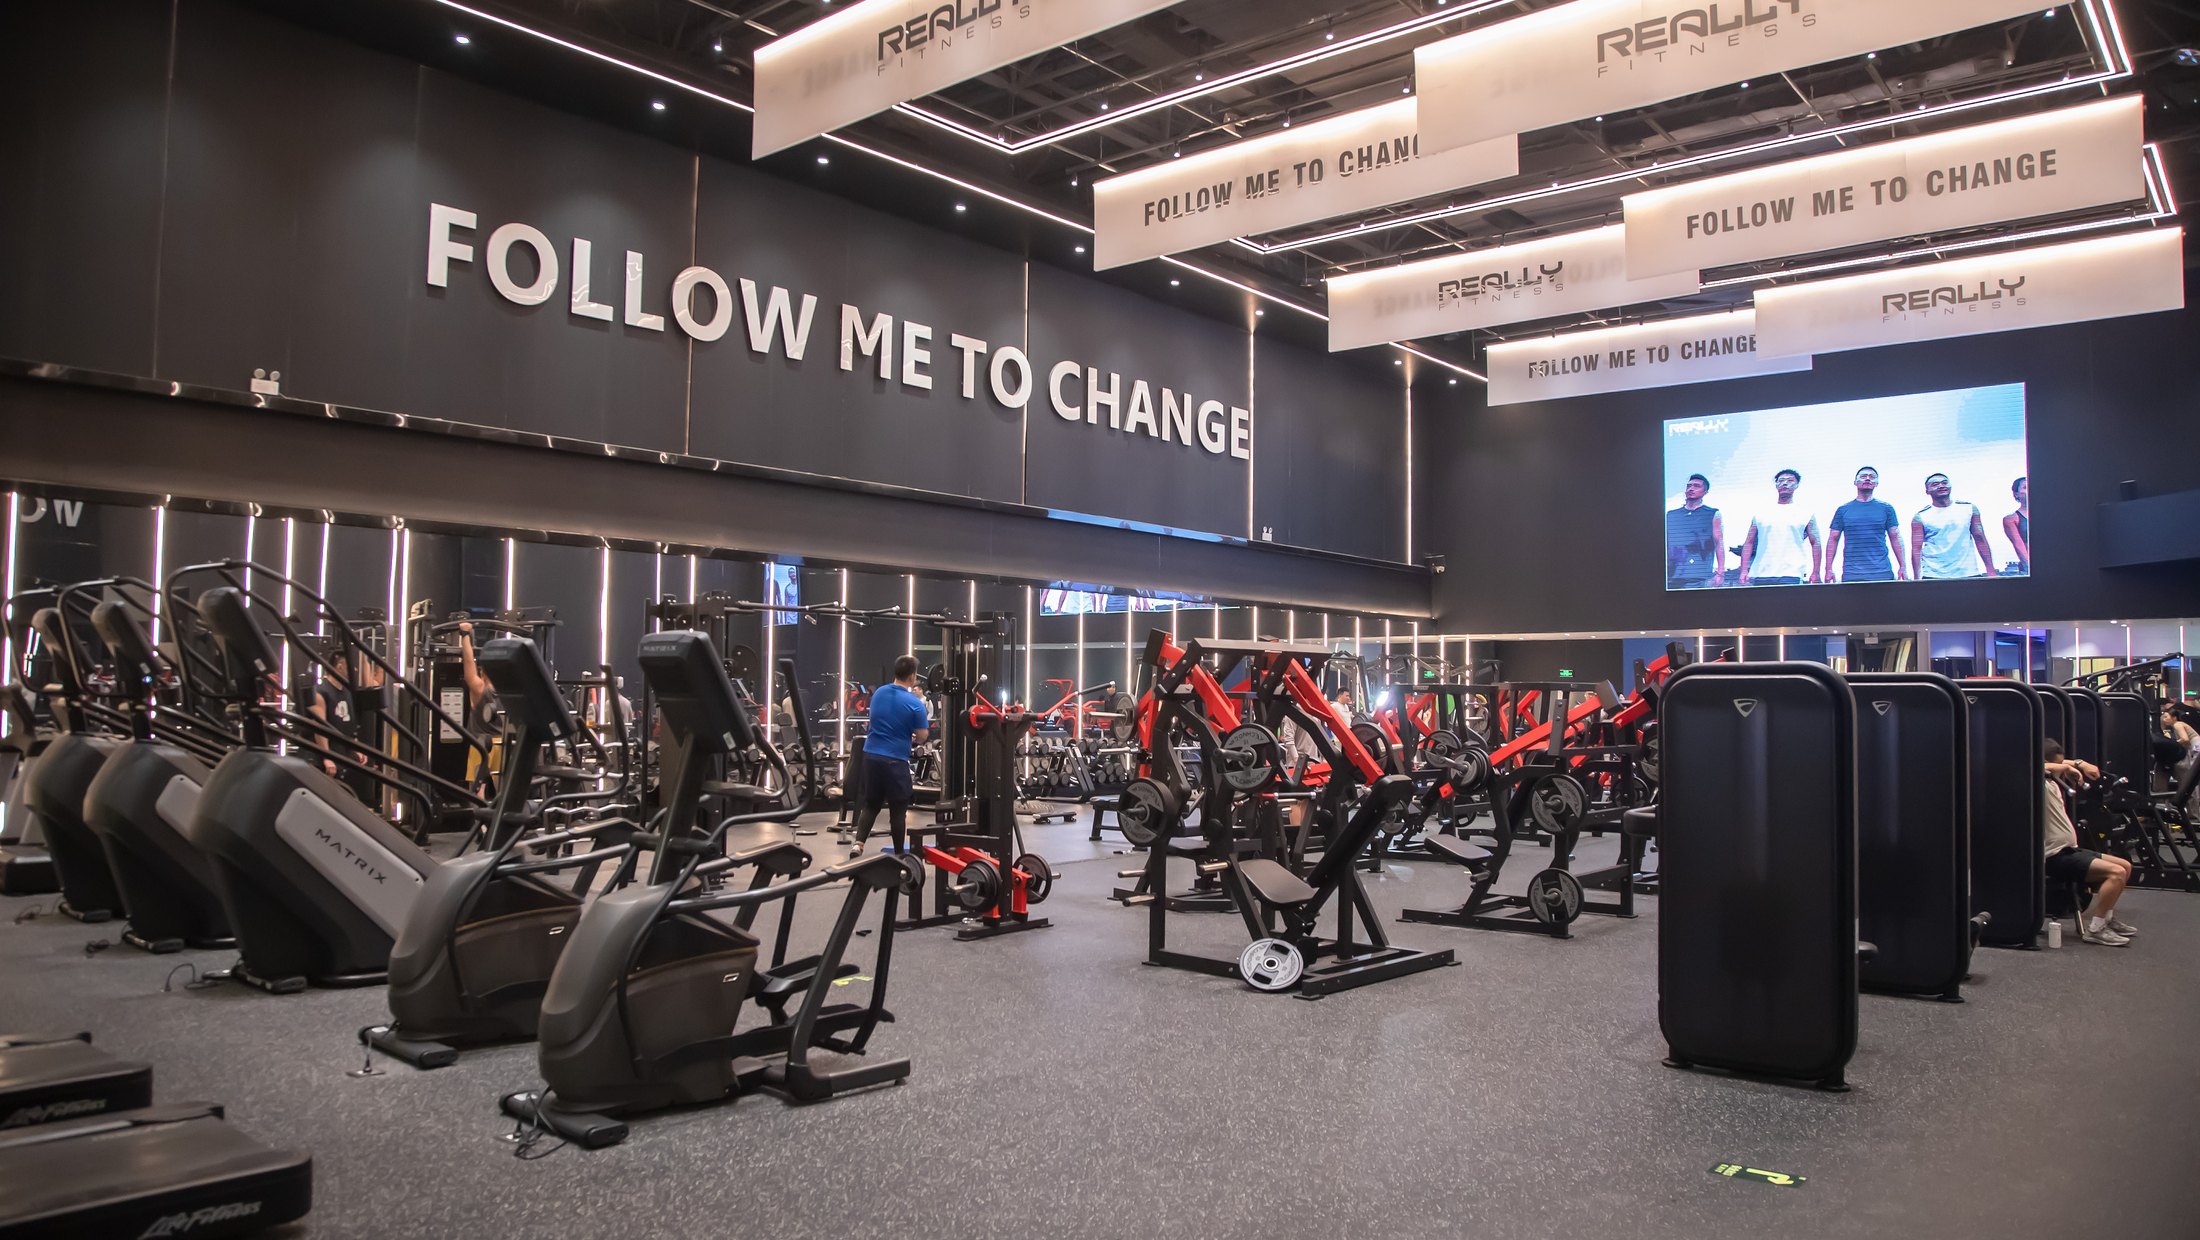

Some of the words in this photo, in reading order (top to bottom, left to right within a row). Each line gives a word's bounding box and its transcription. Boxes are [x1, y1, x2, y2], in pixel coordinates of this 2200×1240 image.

[878, 0, 1018, 61] REALL
[878, 5, 1030, 76] FITNESS
[1598, 13, 1816, 78] FITNESS
[1144, 181, 1233, 226] FOLLOW
[1246, 169, 1280, 199] ME
[1293, 158, 1324, 188] TO
[1338, 133, 1420, 178] CHAN
[1687, 197, 1795, 239] FOLLOW
[1812, 186, 1854, 217] ME
[1870, 176, 1907, 206] TO
[1926, 149, 2057, 197] CHANGE
[1438, 261, 1563, 301] REALLY
[1438, 283, 1564, 311] FITNESS
[1882, 276, 2025, 314] REALLY
[426, 202, 817, 361] FOLLOW
[839, 303, 933, 389] ME
[951, 332, 1034, 409] TO
[1048, 360, 1251, 460] CHANGE
[1883, 298, 2026, 323] FITNESS
[1528, 354, 1599, 378] FOLLOW
[1609, 349, 1636, 369] ME
[1646, 344, 1670, 364] TO
[1680, 334, 1757, 360] CHANGE
[315, 829, 387, 884] MATRIX
